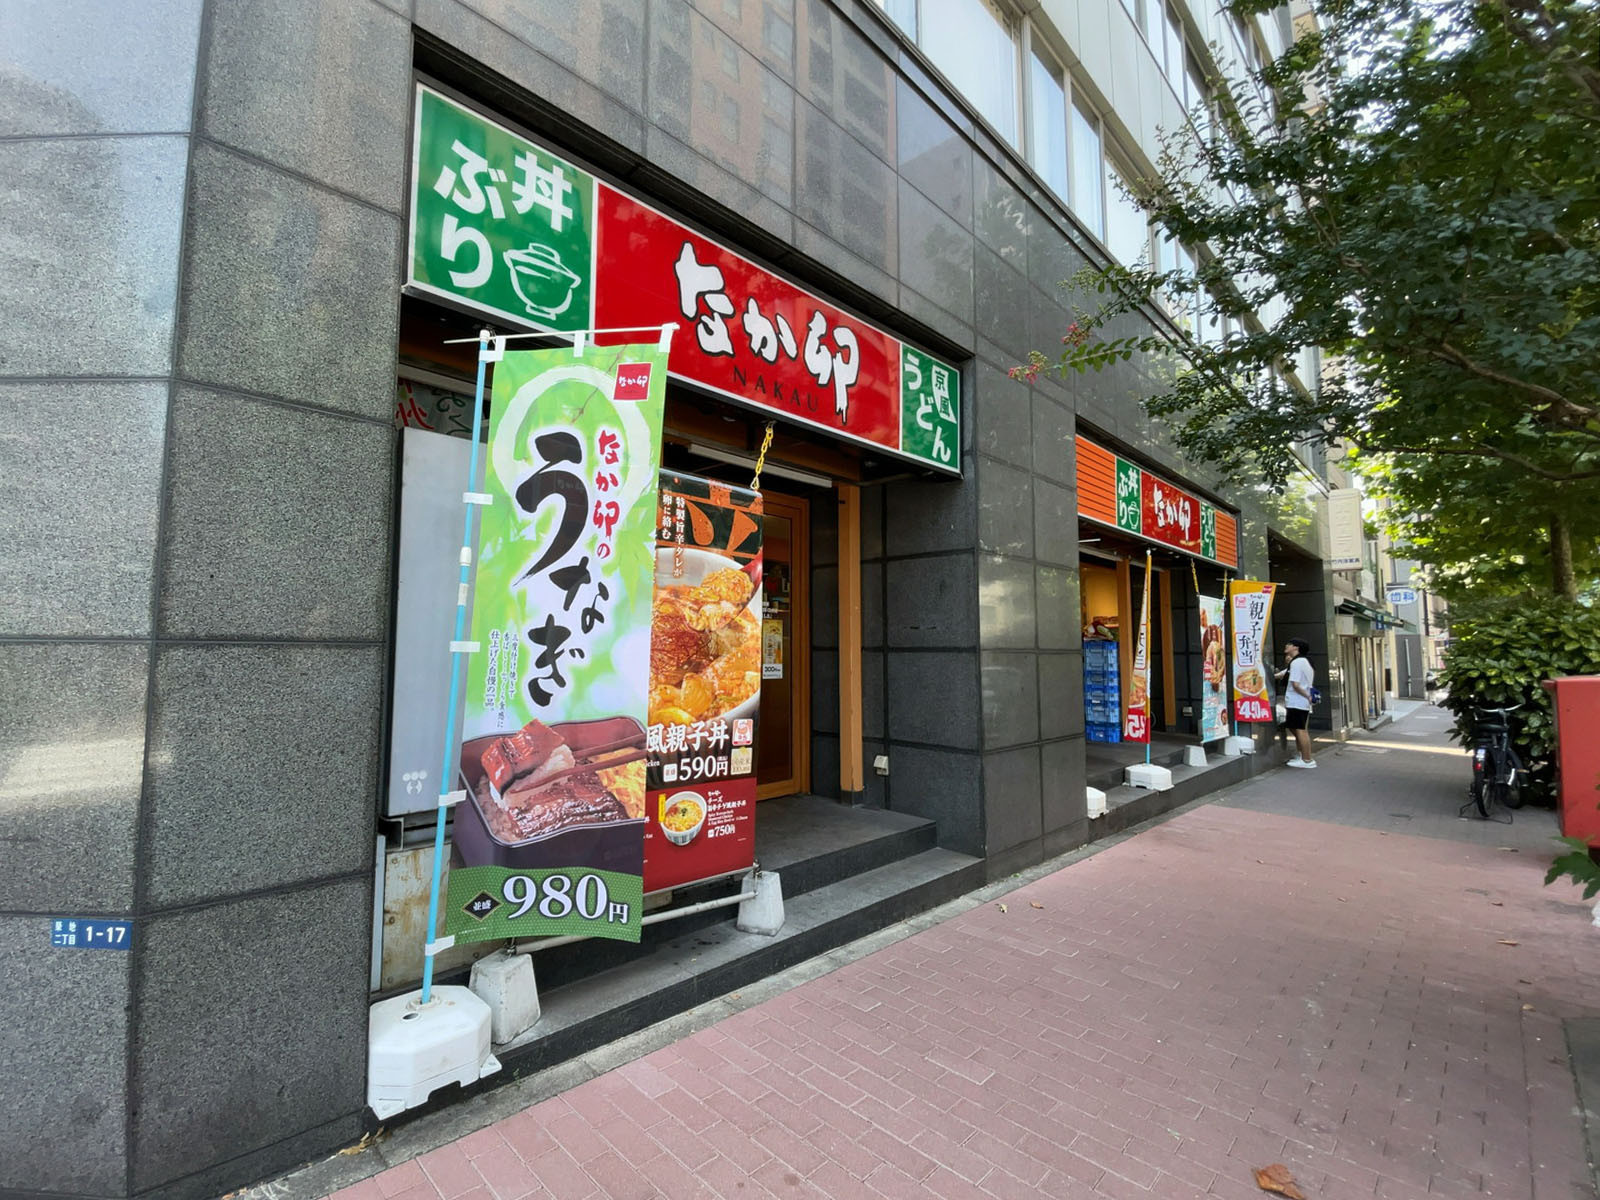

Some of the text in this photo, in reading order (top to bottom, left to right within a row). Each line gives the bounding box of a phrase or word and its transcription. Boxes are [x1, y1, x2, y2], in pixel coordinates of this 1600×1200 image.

[674, 240, 861, 426] なか卯
[618, 375, 648, 388] なか卯
[732, 364, 819, 413] NAKAU
[904, 352, 952, 463] うどん
[593, 430, 621, 560] なか卯の
[1153, 483, 1191, 543] なか卯
[512, 431, 609, 708] うなぎ
[502, 873, 629, 925] 980円
[54, 934, 76, 945] 二丁目
[86, 926, 126, 943] 1-17
